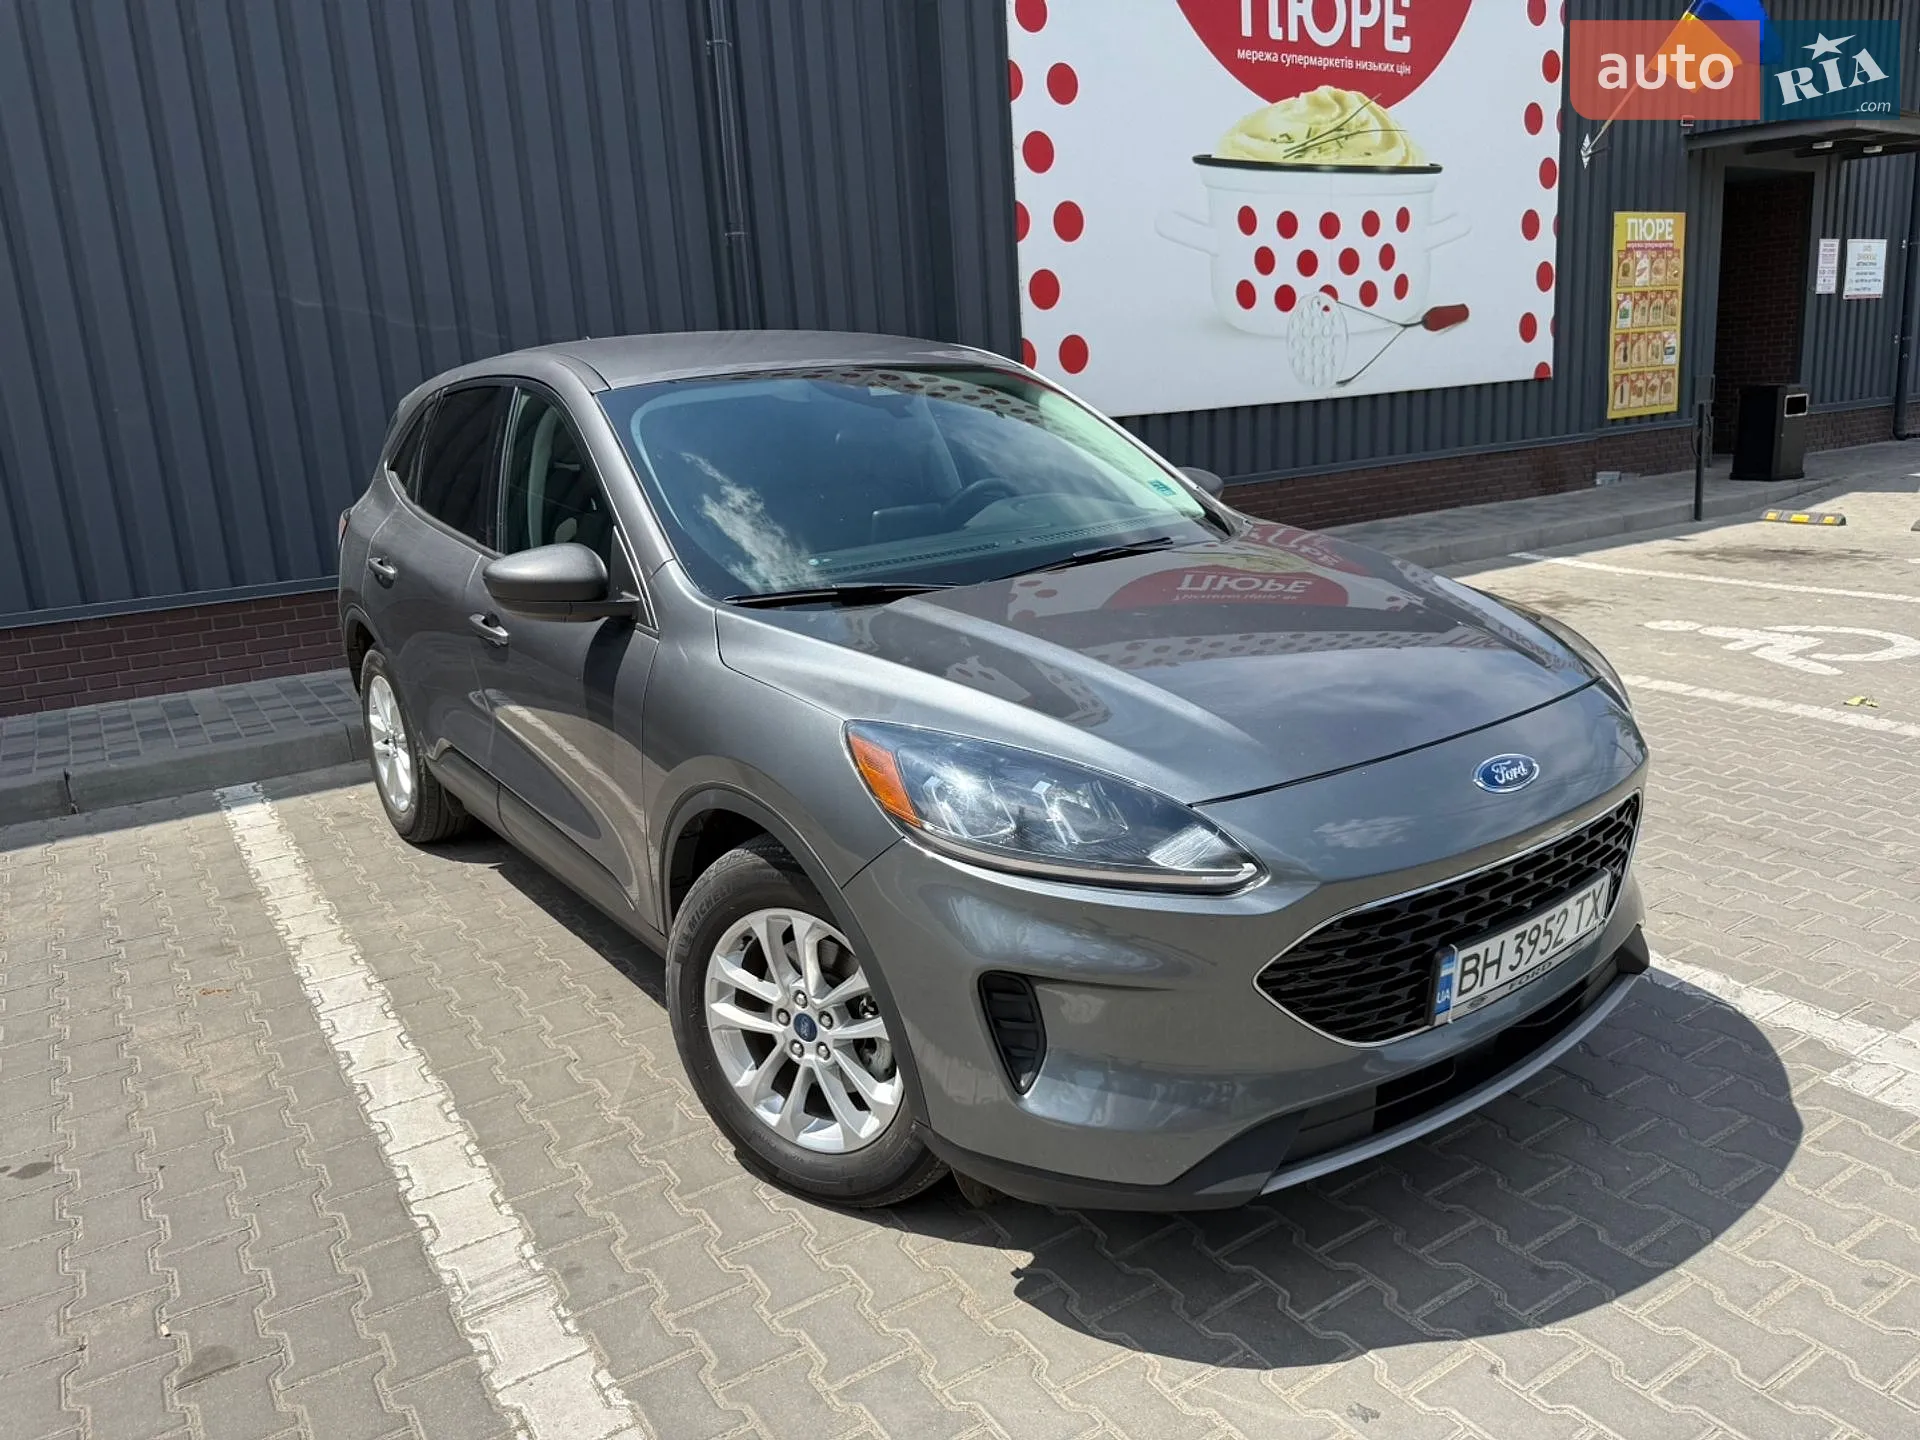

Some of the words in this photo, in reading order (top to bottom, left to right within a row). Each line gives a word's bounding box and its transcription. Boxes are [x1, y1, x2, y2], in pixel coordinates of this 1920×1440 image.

[1241, 0, 1412, 53] ПЮРЕ
[1237, 49, 1279, 64] мережа
[1280, 54, 1354, 70] супермаркетів
[1355, 58, 1395, 73] низьких
[1396, 62, 1412, 76] цін
[1626, 218, 1674, 241] ПЮРЕ
[1491, 759, 1528, 785] Ford
[1456, 940, 1505, 998] BH
[1508, 908, 1569, 972] 3952
[1575, 882, 1606, 935] TX
